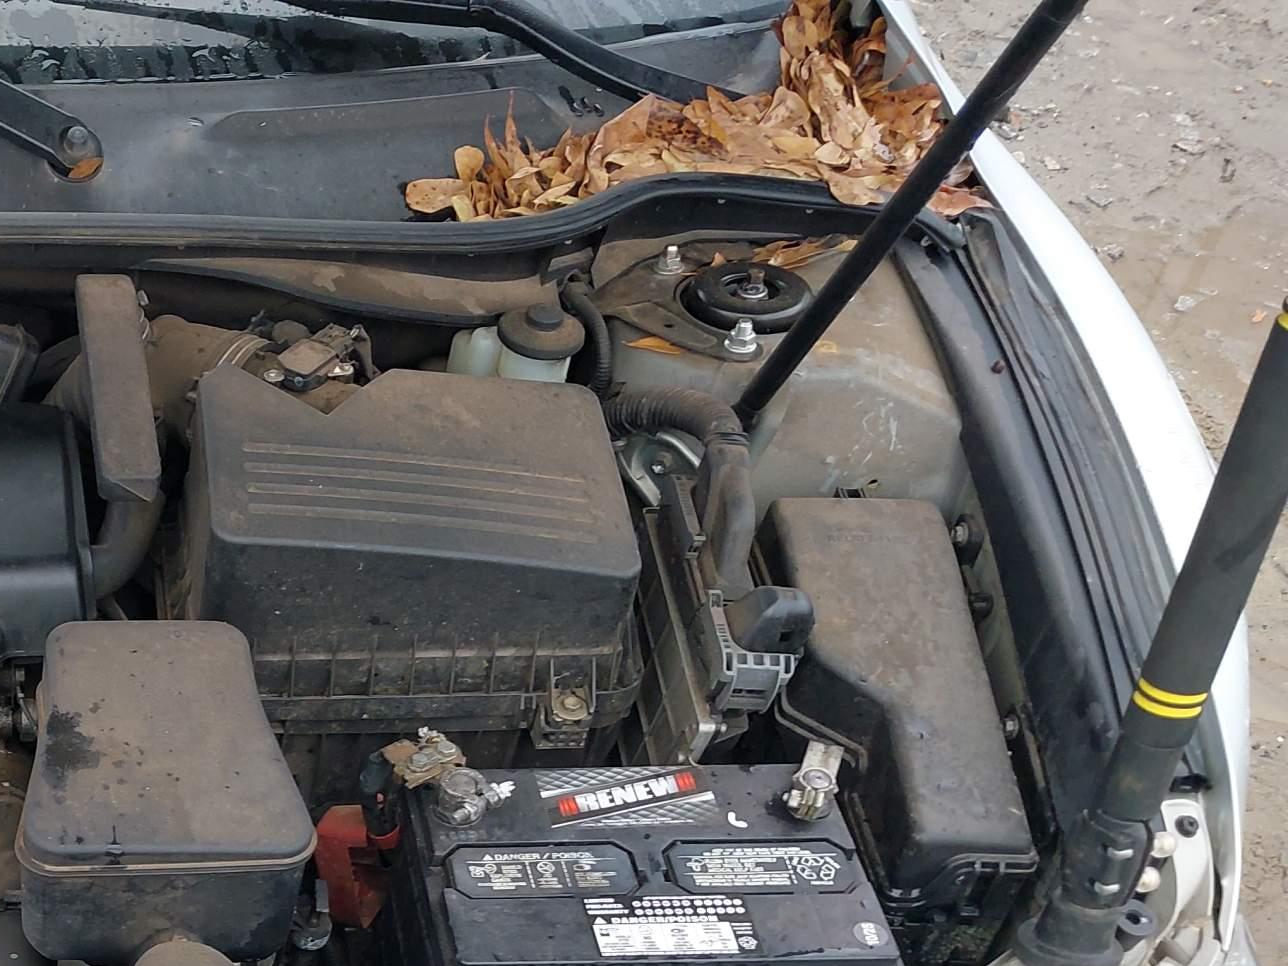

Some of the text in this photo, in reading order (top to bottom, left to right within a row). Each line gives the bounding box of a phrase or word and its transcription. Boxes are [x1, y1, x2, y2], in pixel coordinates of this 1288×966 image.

[573, 775, 680, 813] RENEW
[494, 853, 541, 861] DANGER
[610, 915, 719, 924] DANGER/POISON
